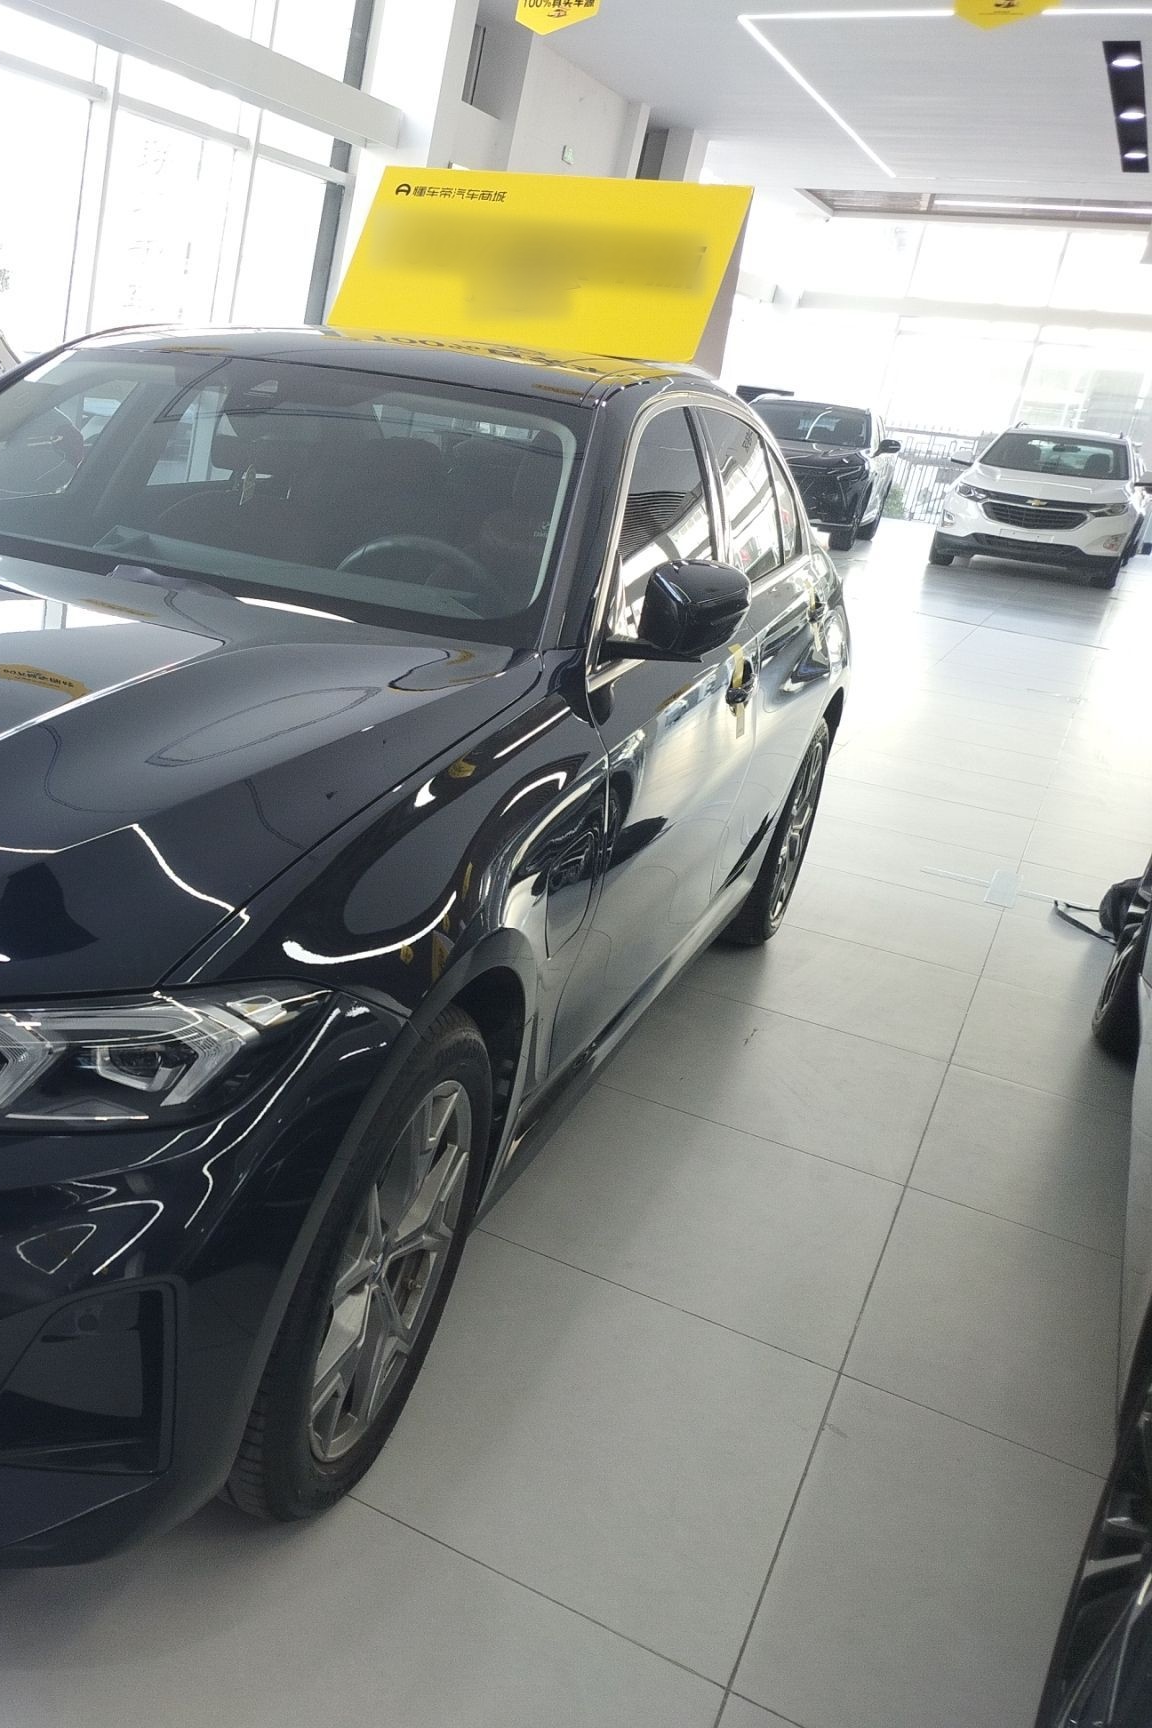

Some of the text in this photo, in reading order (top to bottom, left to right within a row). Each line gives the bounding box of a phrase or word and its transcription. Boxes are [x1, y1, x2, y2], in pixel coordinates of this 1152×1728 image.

[413, 185, 508, 203] 懂车帝汽车商城
